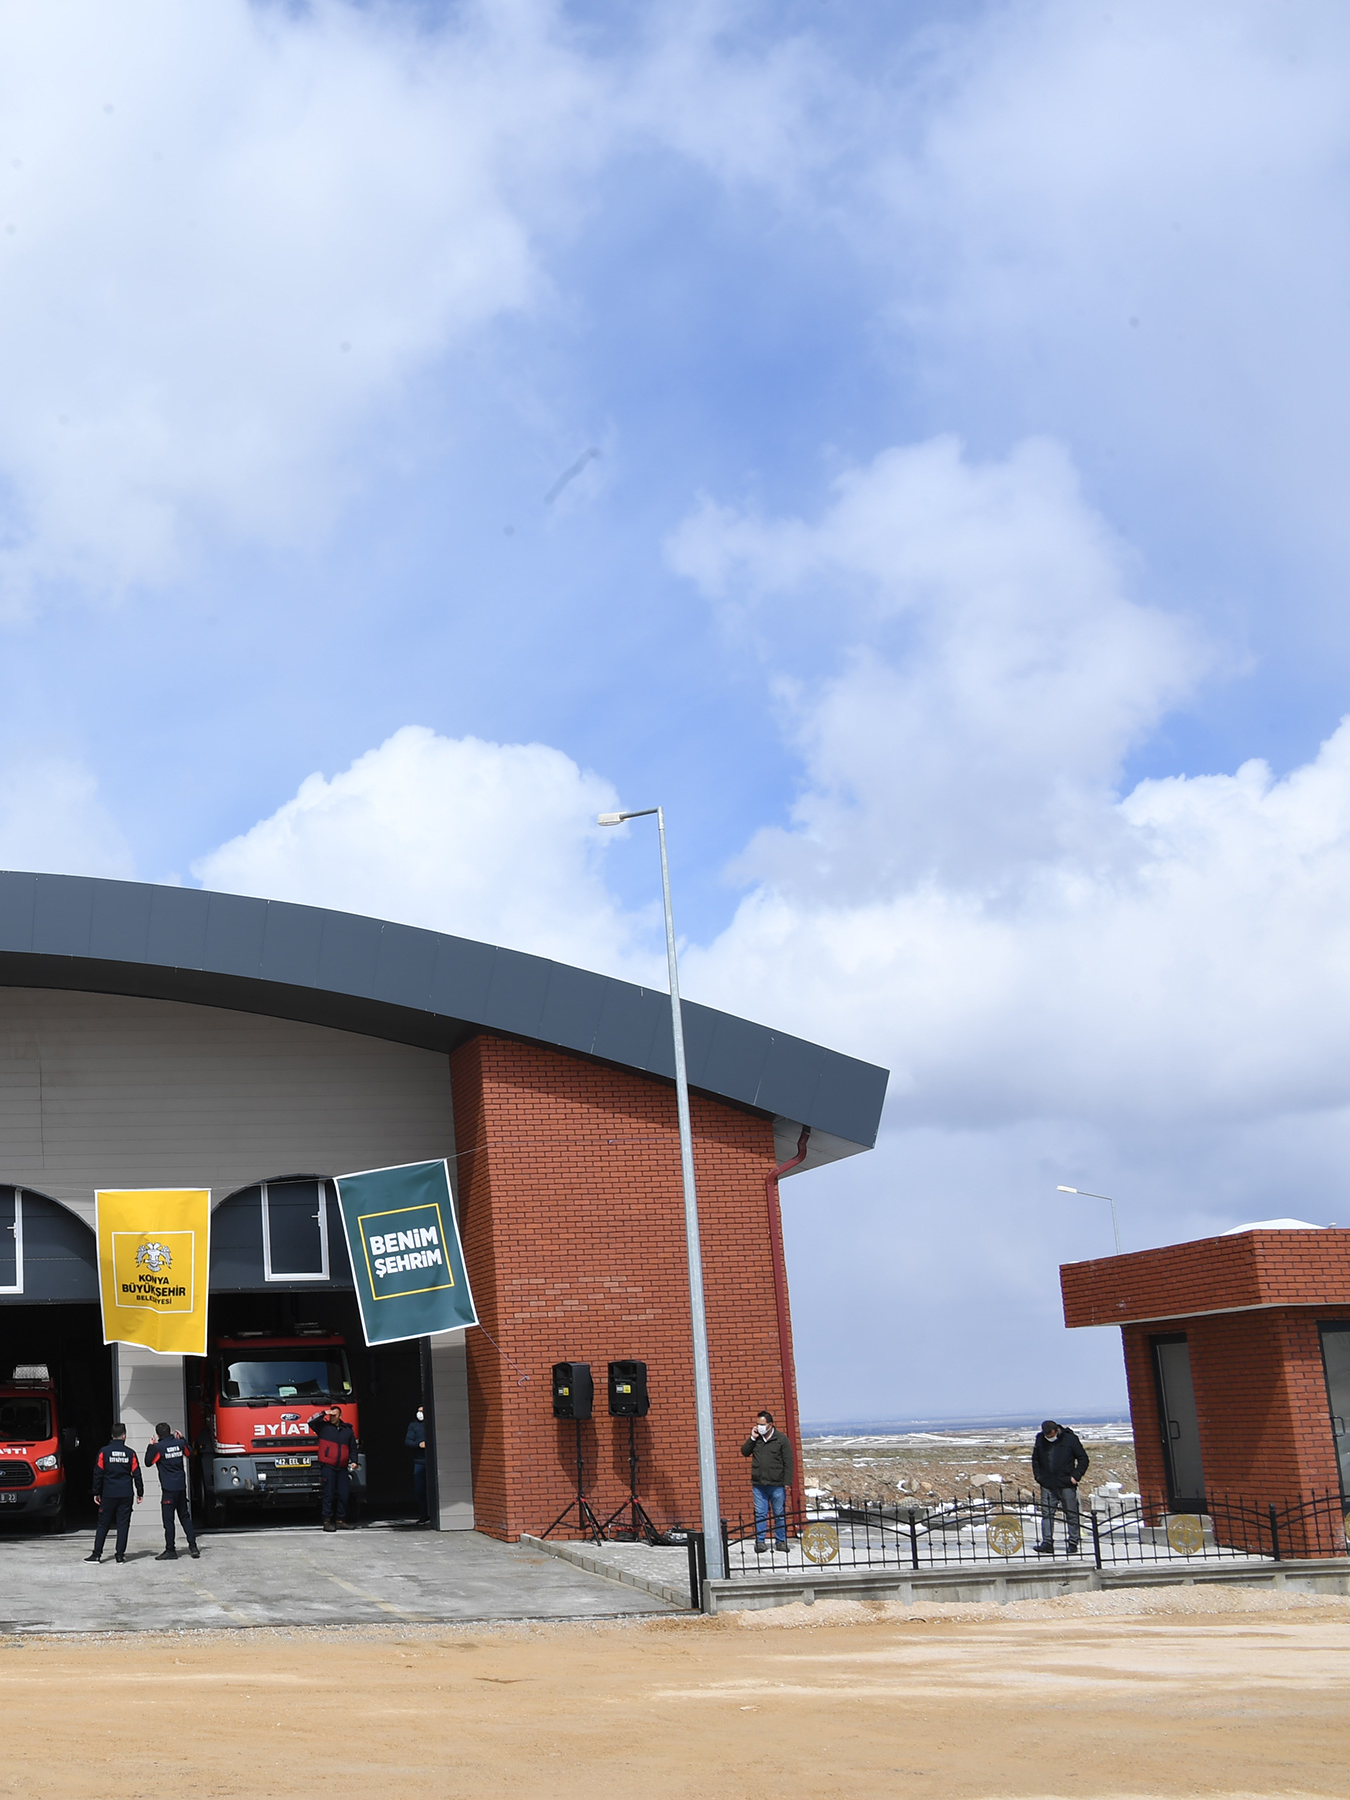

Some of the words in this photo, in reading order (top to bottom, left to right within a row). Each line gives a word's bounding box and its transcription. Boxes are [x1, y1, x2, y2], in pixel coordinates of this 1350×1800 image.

[369, 1226, 439, 1256] BENİM
[374, 1248, 443, 1278] ŞEHRİM
[122, 1282, 186, 1297] BÜYÜKŞEHİR
[138, 1274, 170, 1285] KONYA
